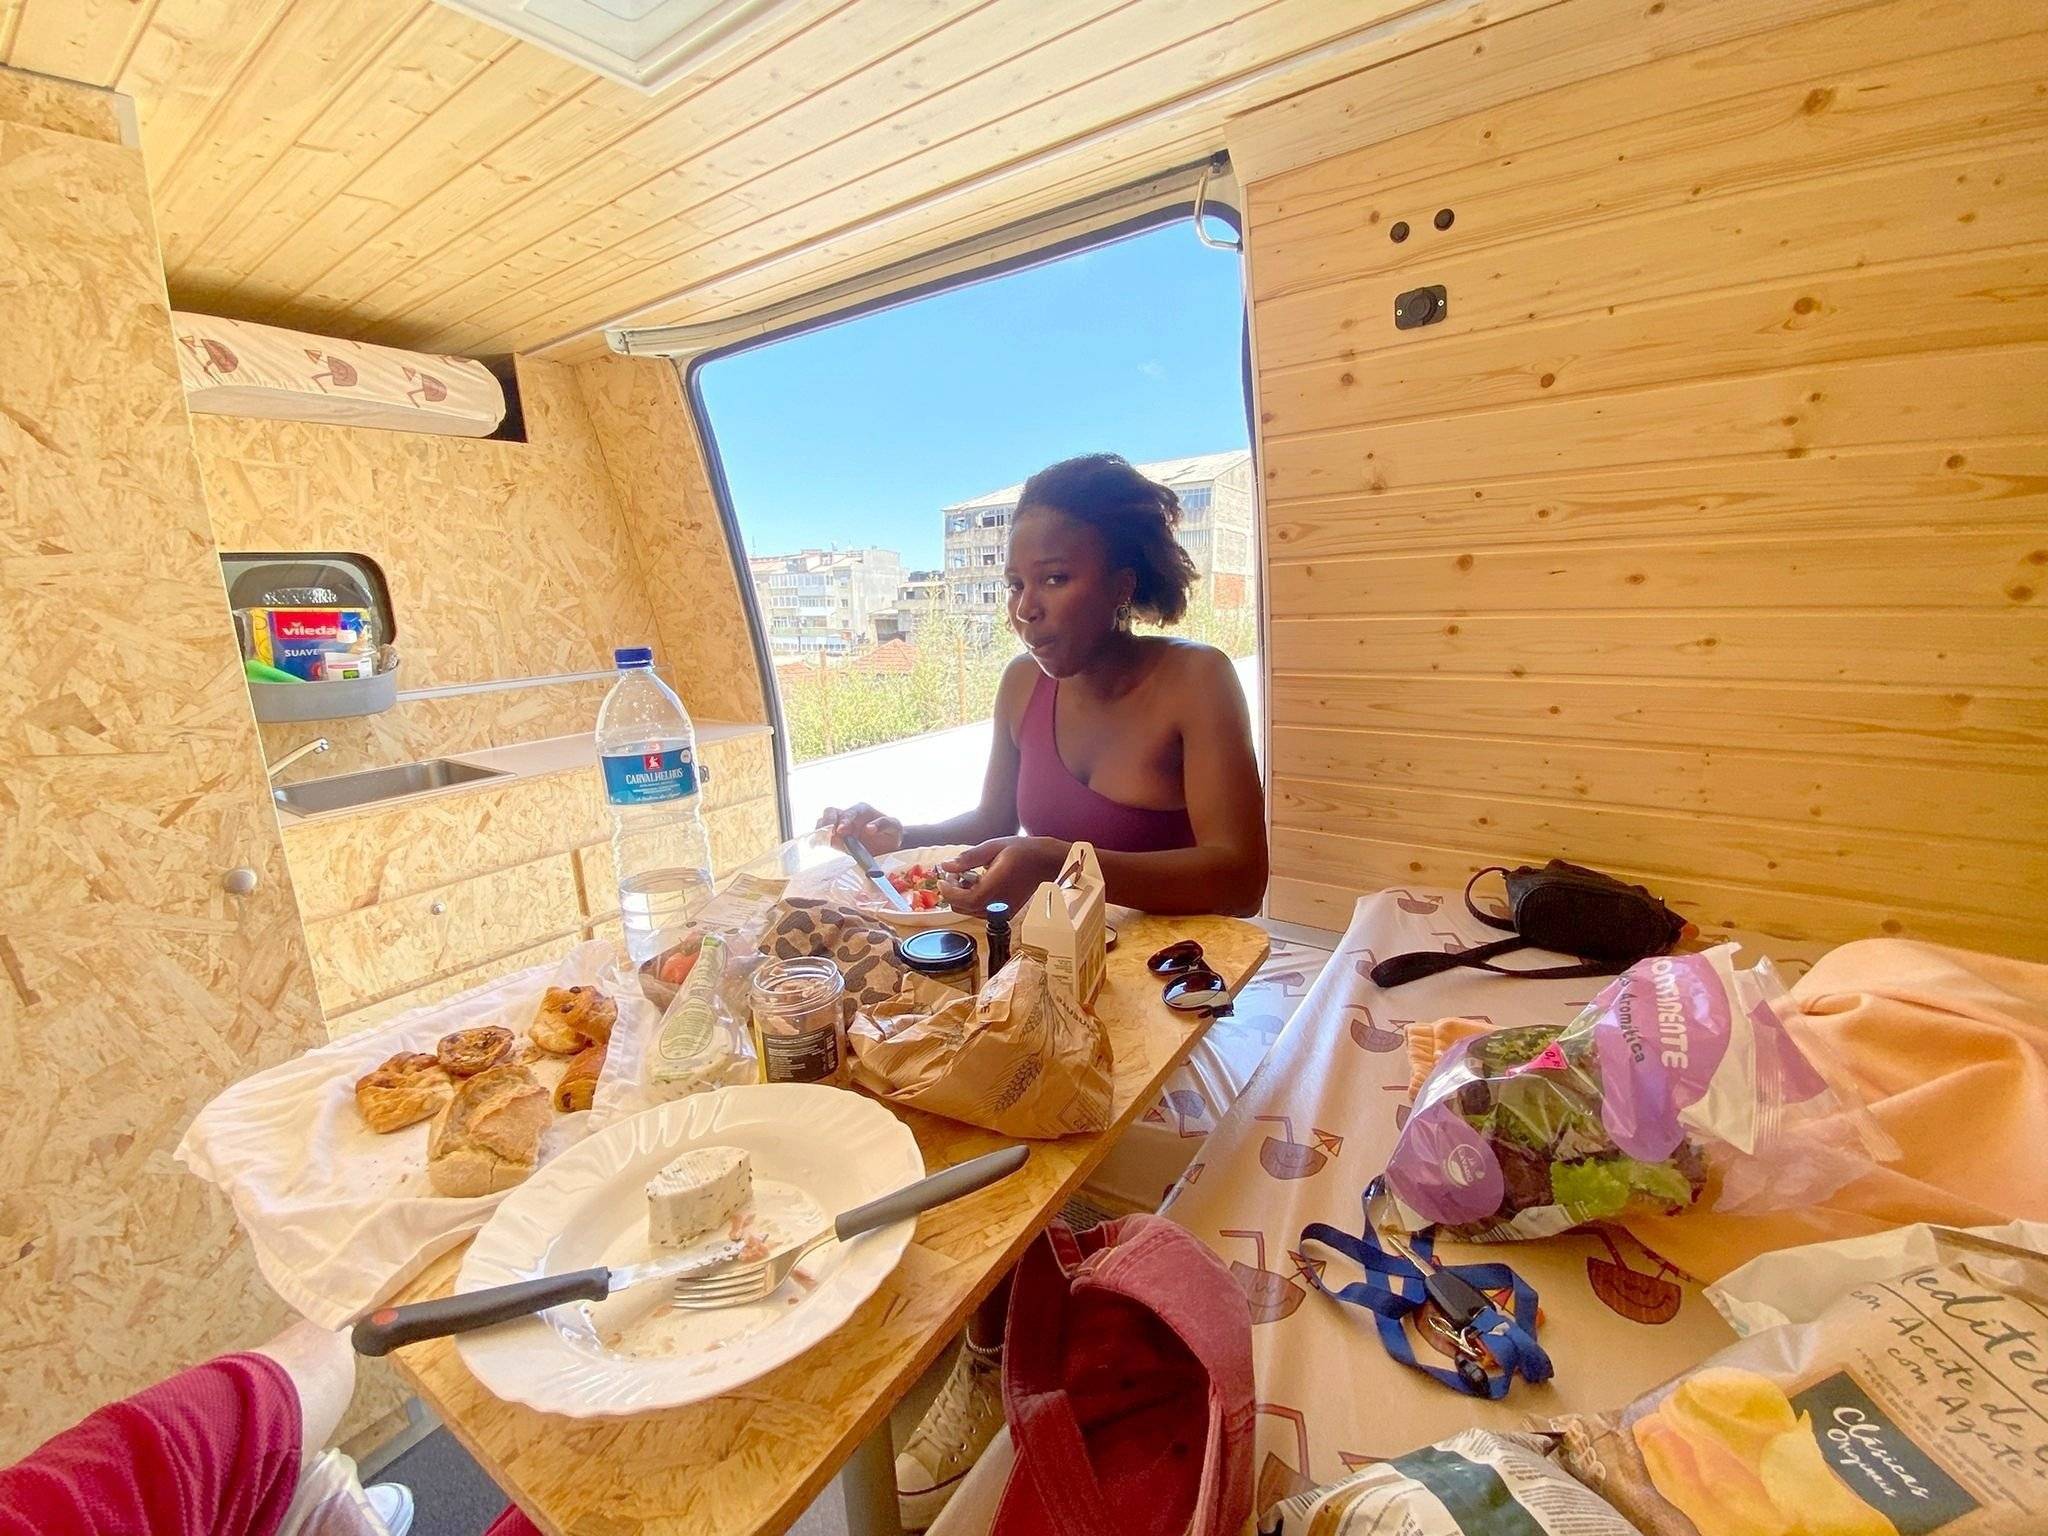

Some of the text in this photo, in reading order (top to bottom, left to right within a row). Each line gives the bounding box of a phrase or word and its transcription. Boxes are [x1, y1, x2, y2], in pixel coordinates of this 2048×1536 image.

[281, 622, 337, 636] vileda
[1619, 992, 1646, 1064] Aromática
[1650, 956, 1689, 1069] ONTINENTE
[1851, 1290, 1881, 1311] con
[1901, 1265, 2048, 1396] edite
[1887, 1348, 1928, 1386] com
[1888, 1316, 1975, 1392] Aceite
[1980, 1403, 2028, 1438] de
